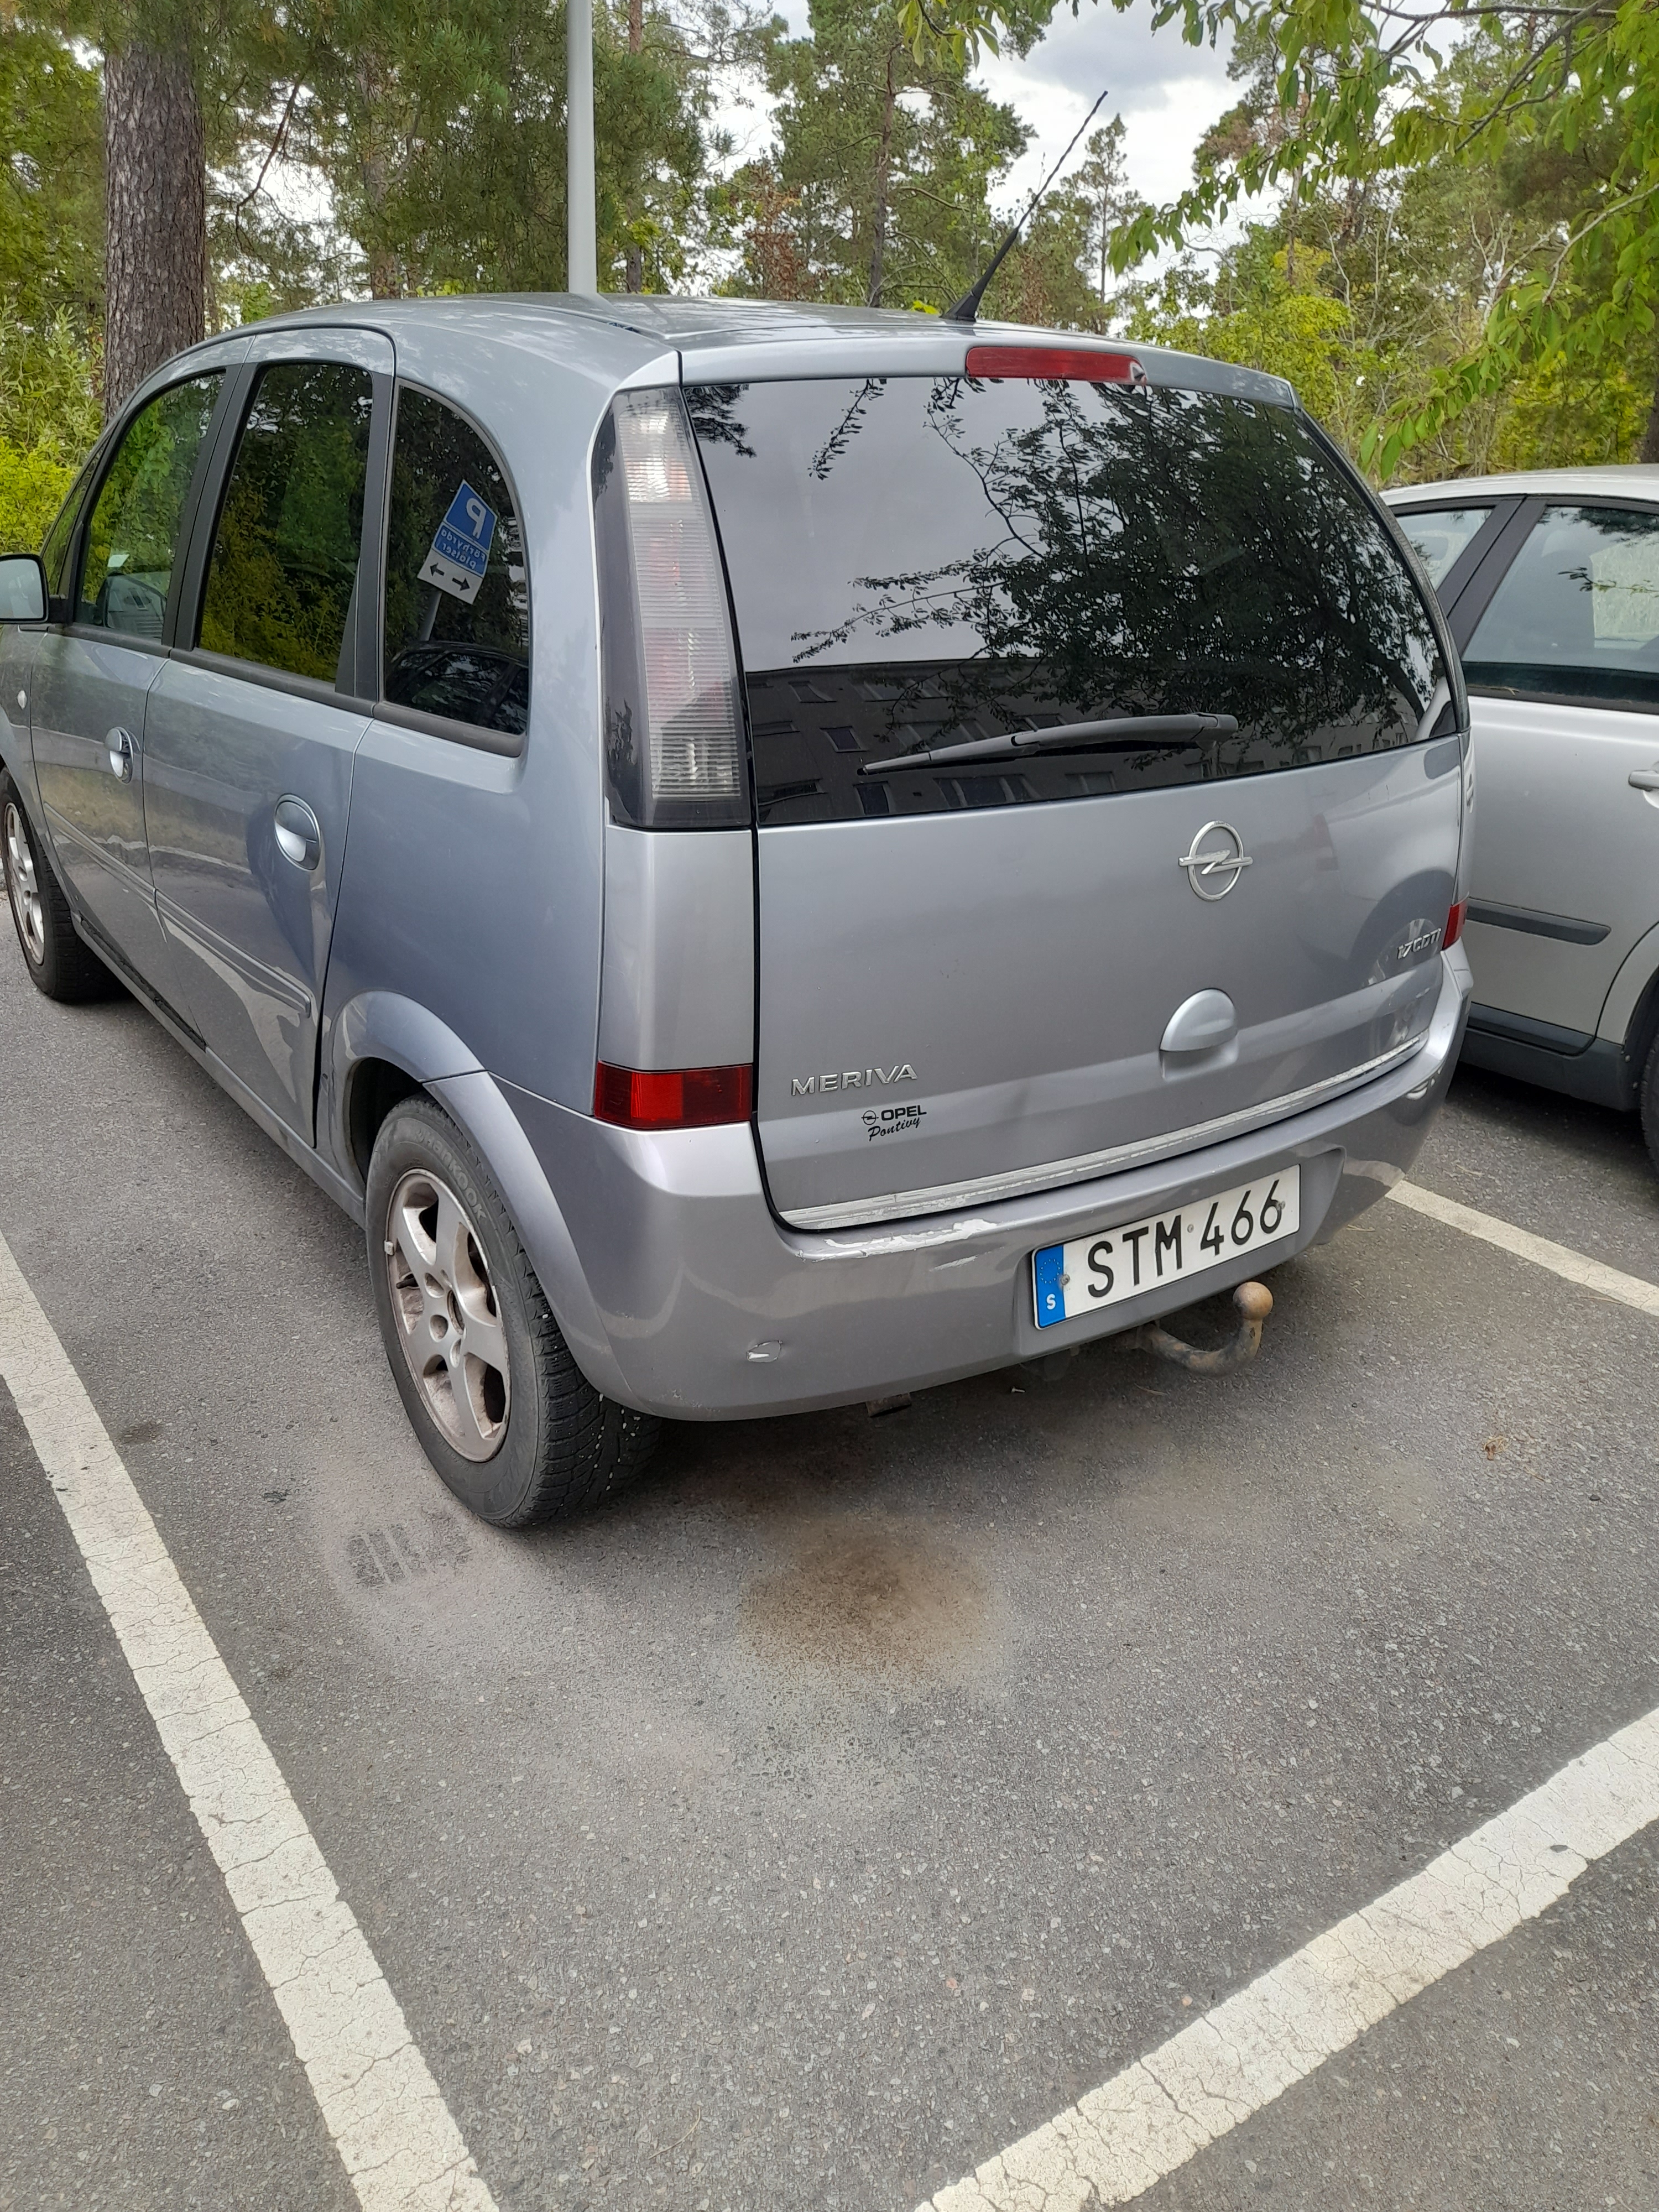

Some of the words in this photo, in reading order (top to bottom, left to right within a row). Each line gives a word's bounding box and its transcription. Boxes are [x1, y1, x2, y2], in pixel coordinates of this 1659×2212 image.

[791, 1063, 918, 1097] MERIVA
[880, 1105, 927, 1121] OPEL
[867, 1116, 921, 1142] Pontivy
[1087, 1214, 1182, 1298] STM
[1200, 1179, 1282, 1255] 466
[1046, 1293, 1056, 1310] S
